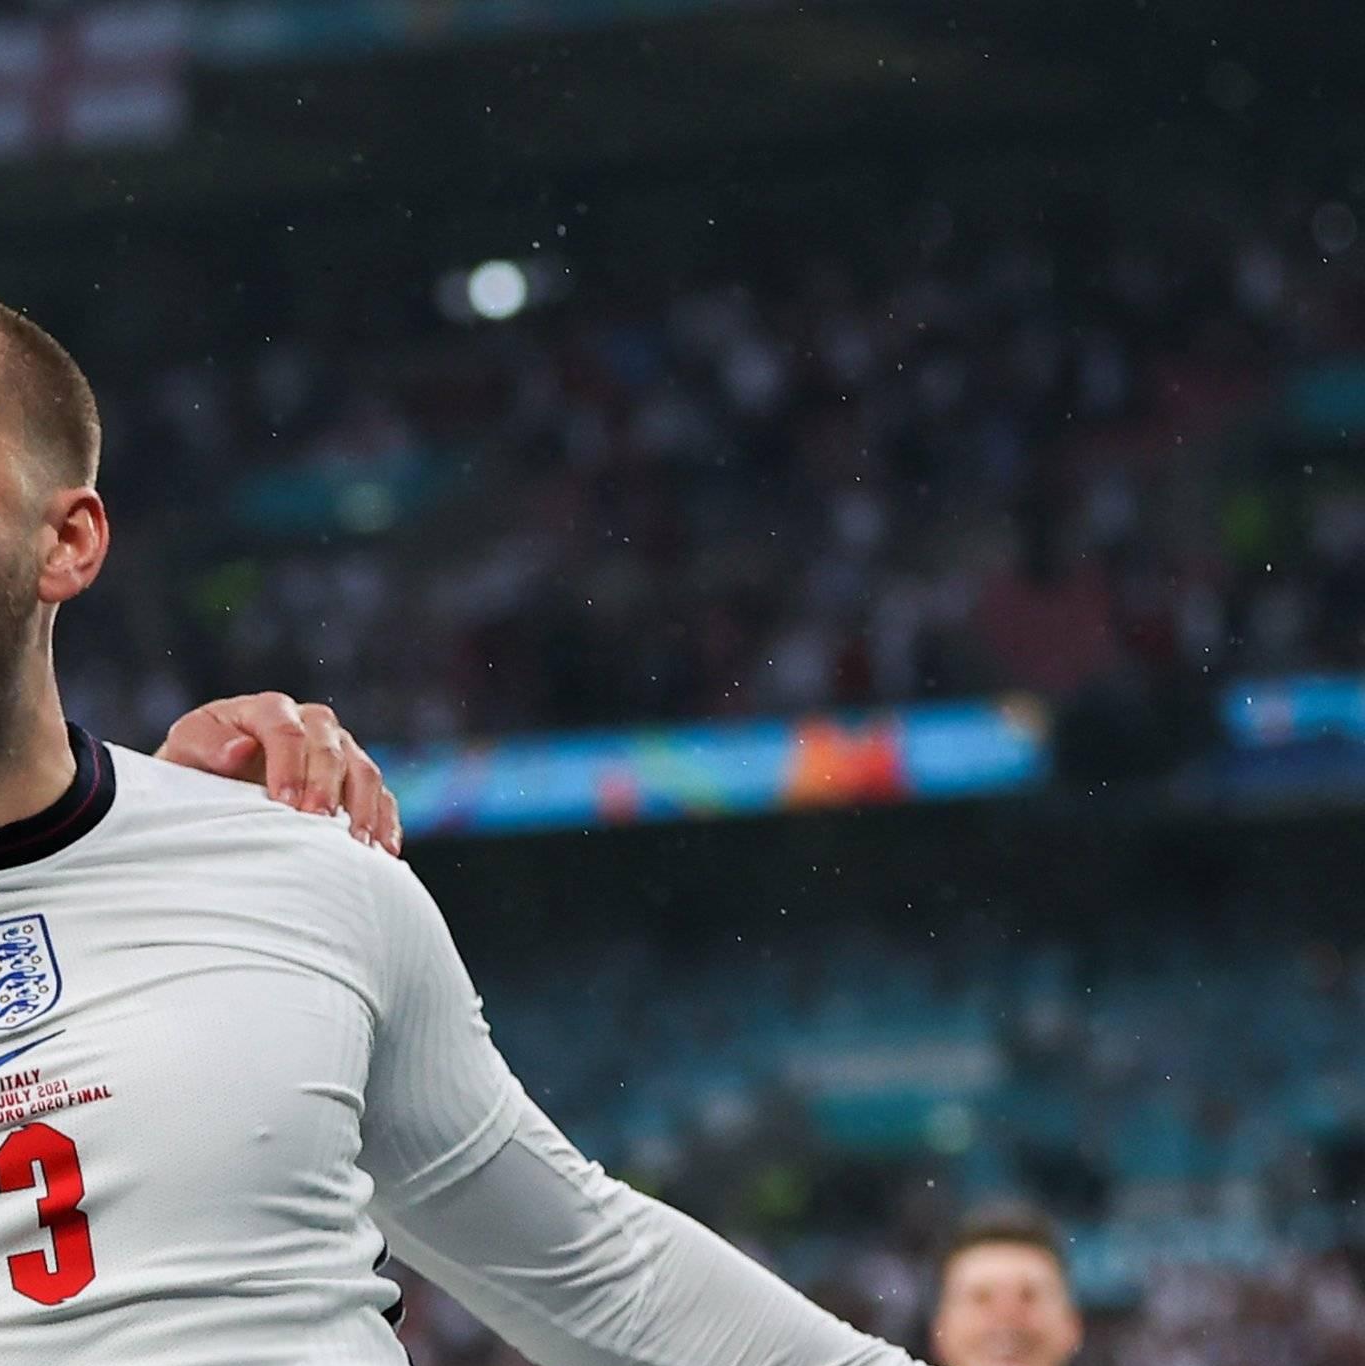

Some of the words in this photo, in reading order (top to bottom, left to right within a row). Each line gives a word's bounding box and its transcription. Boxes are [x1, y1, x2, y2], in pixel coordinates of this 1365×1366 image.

[0, 1068, 41, 1093] ITALY
[37, 1079, 69, 1099] 2021
[29, 1096, 64, 1115] 2020
[67, 1083, 113, 1107] FINAL
